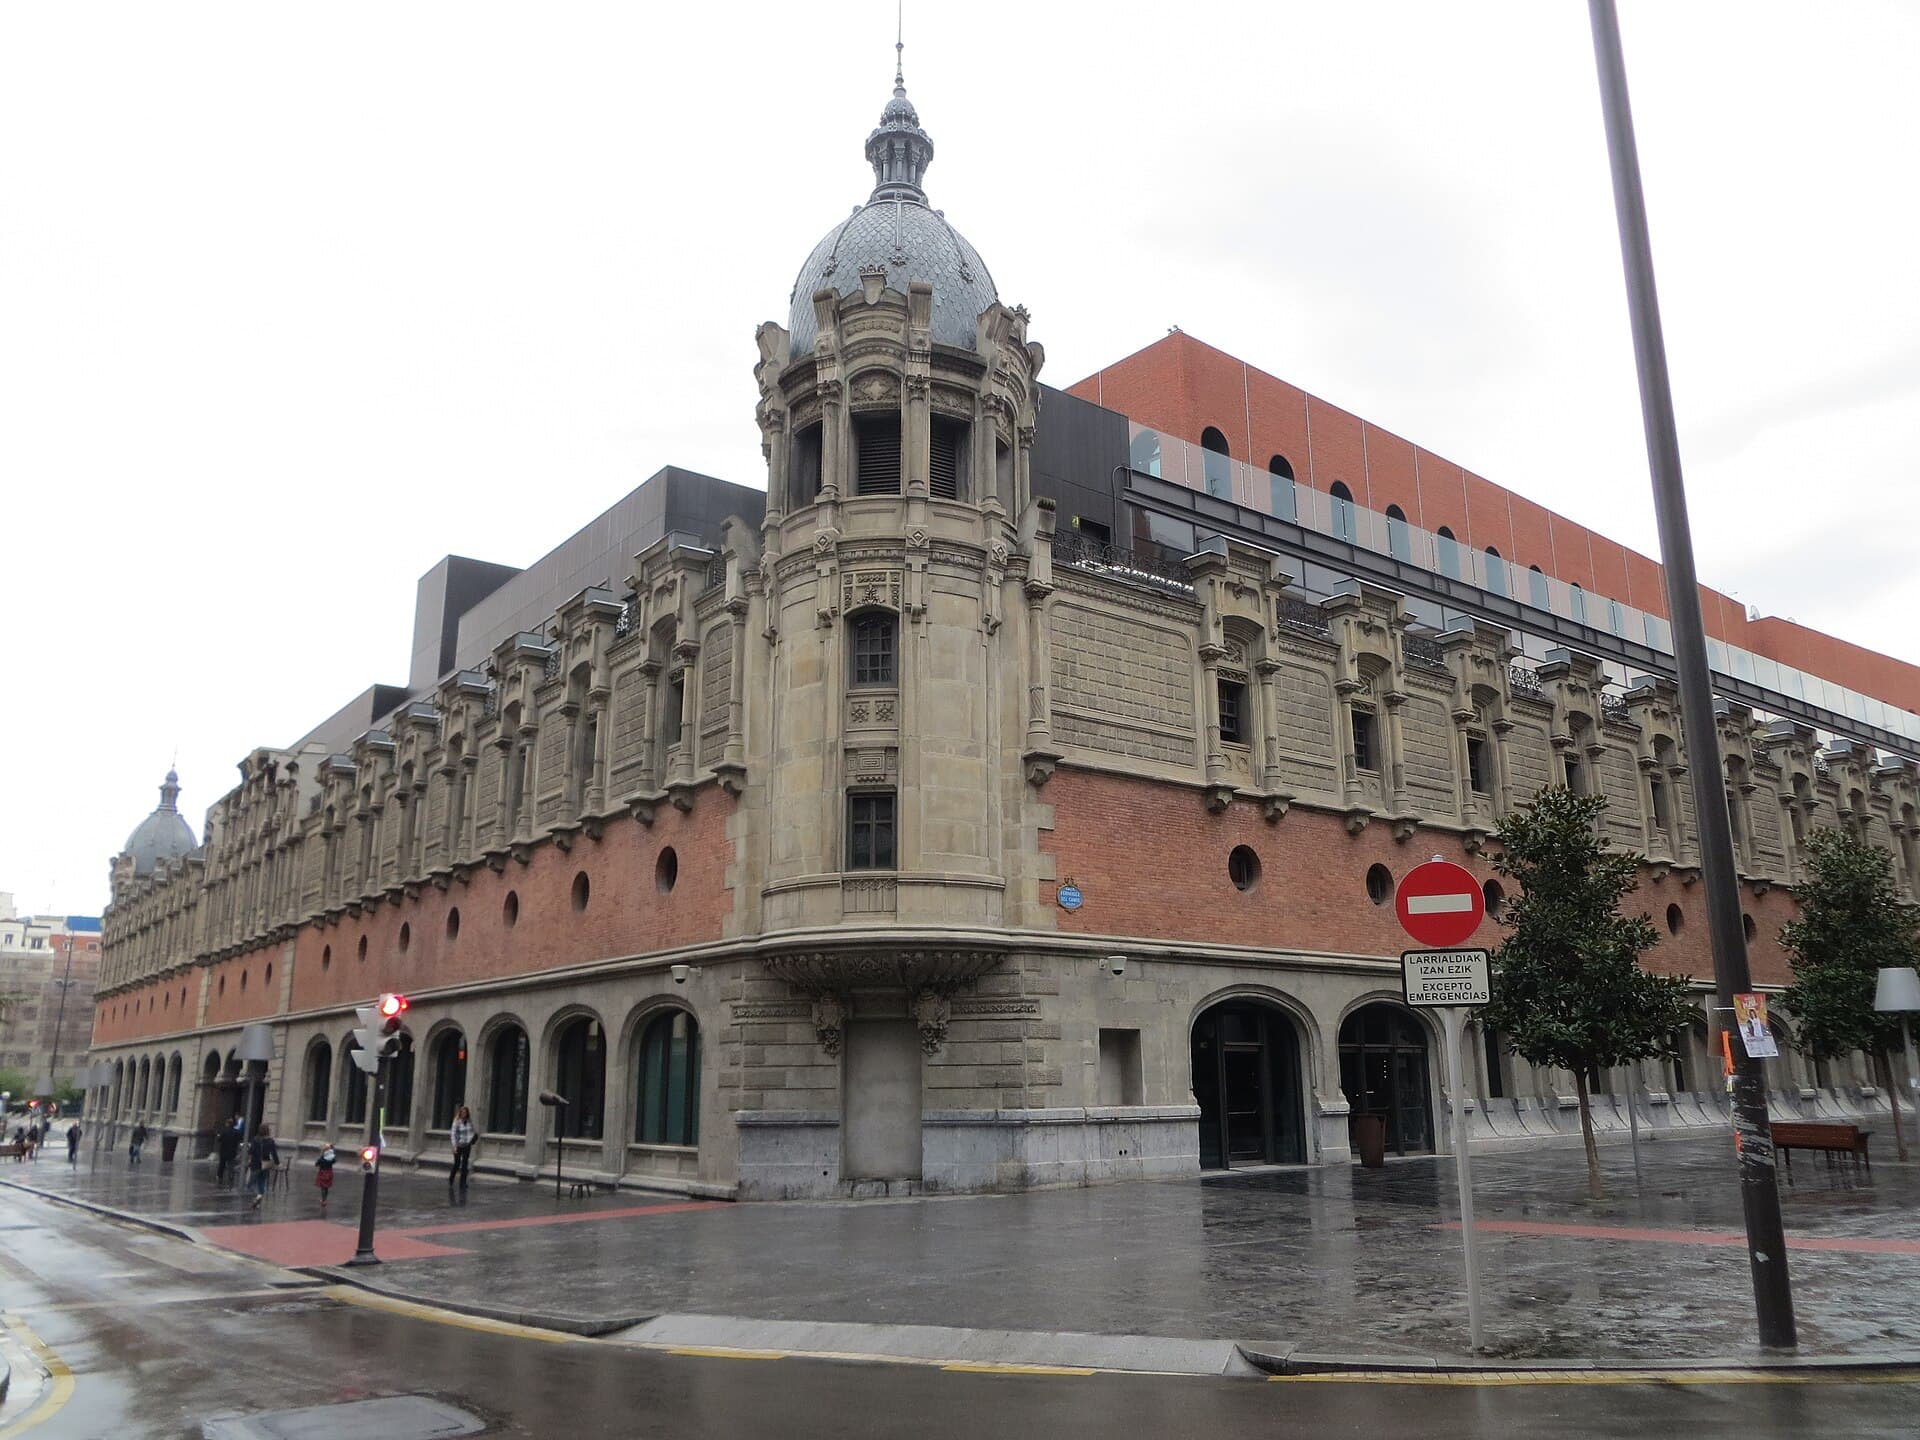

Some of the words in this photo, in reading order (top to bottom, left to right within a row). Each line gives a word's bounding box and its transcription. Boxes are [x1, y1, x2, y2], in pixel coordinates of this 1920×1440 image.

[1409, 955, 1481, 964] LARRIALDIAK
[1420, 966, 1444, 975] IZAN
[1448, 965, 1472, 974] EZIK
[1422, 983, 1472, 991] EXCEPTO
[1409, 992, 1487, 1001] EMERGENCIAS
